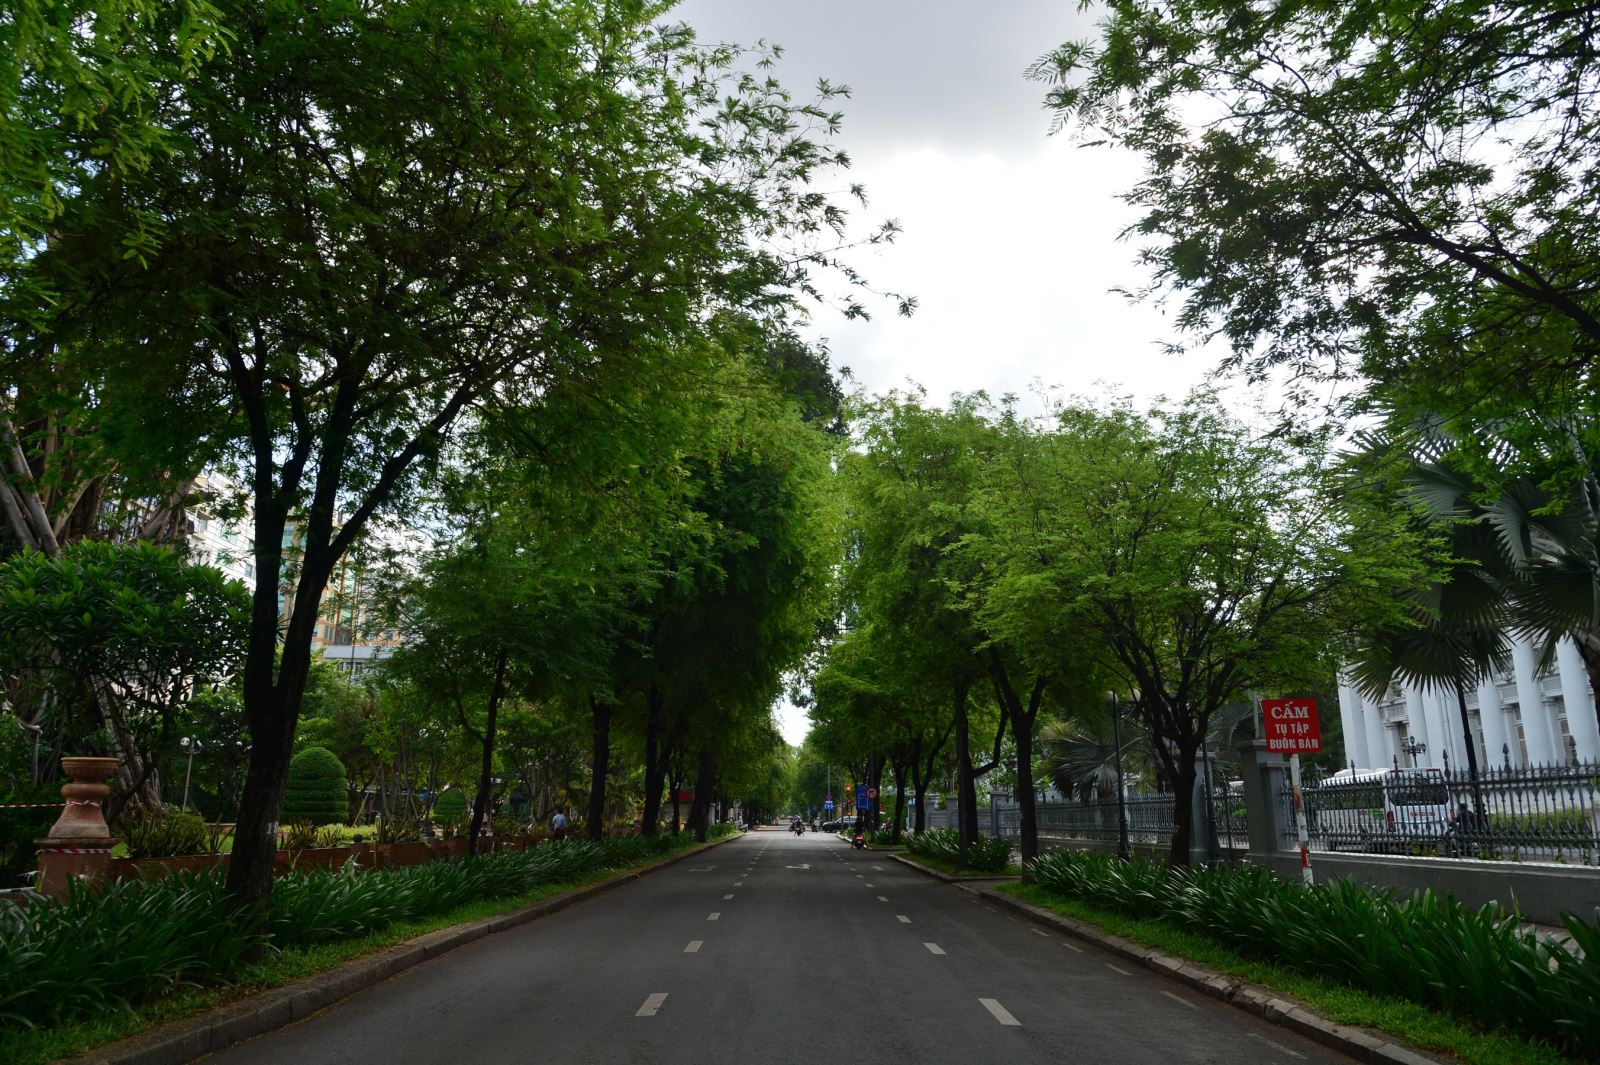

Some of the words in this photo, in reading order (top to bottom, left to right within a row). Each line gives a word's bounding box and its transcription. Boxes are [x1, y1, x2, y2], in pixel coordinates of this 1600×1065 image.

[1271, 701, 1309, 719] CẤM
[1275, 724, 1287, 736] TỤ
[1290, 722, 1309, 735] TẬP
[1270, 737, 1296, 749] BUÔN
[1298, 736, 1318, 749] BÁN
